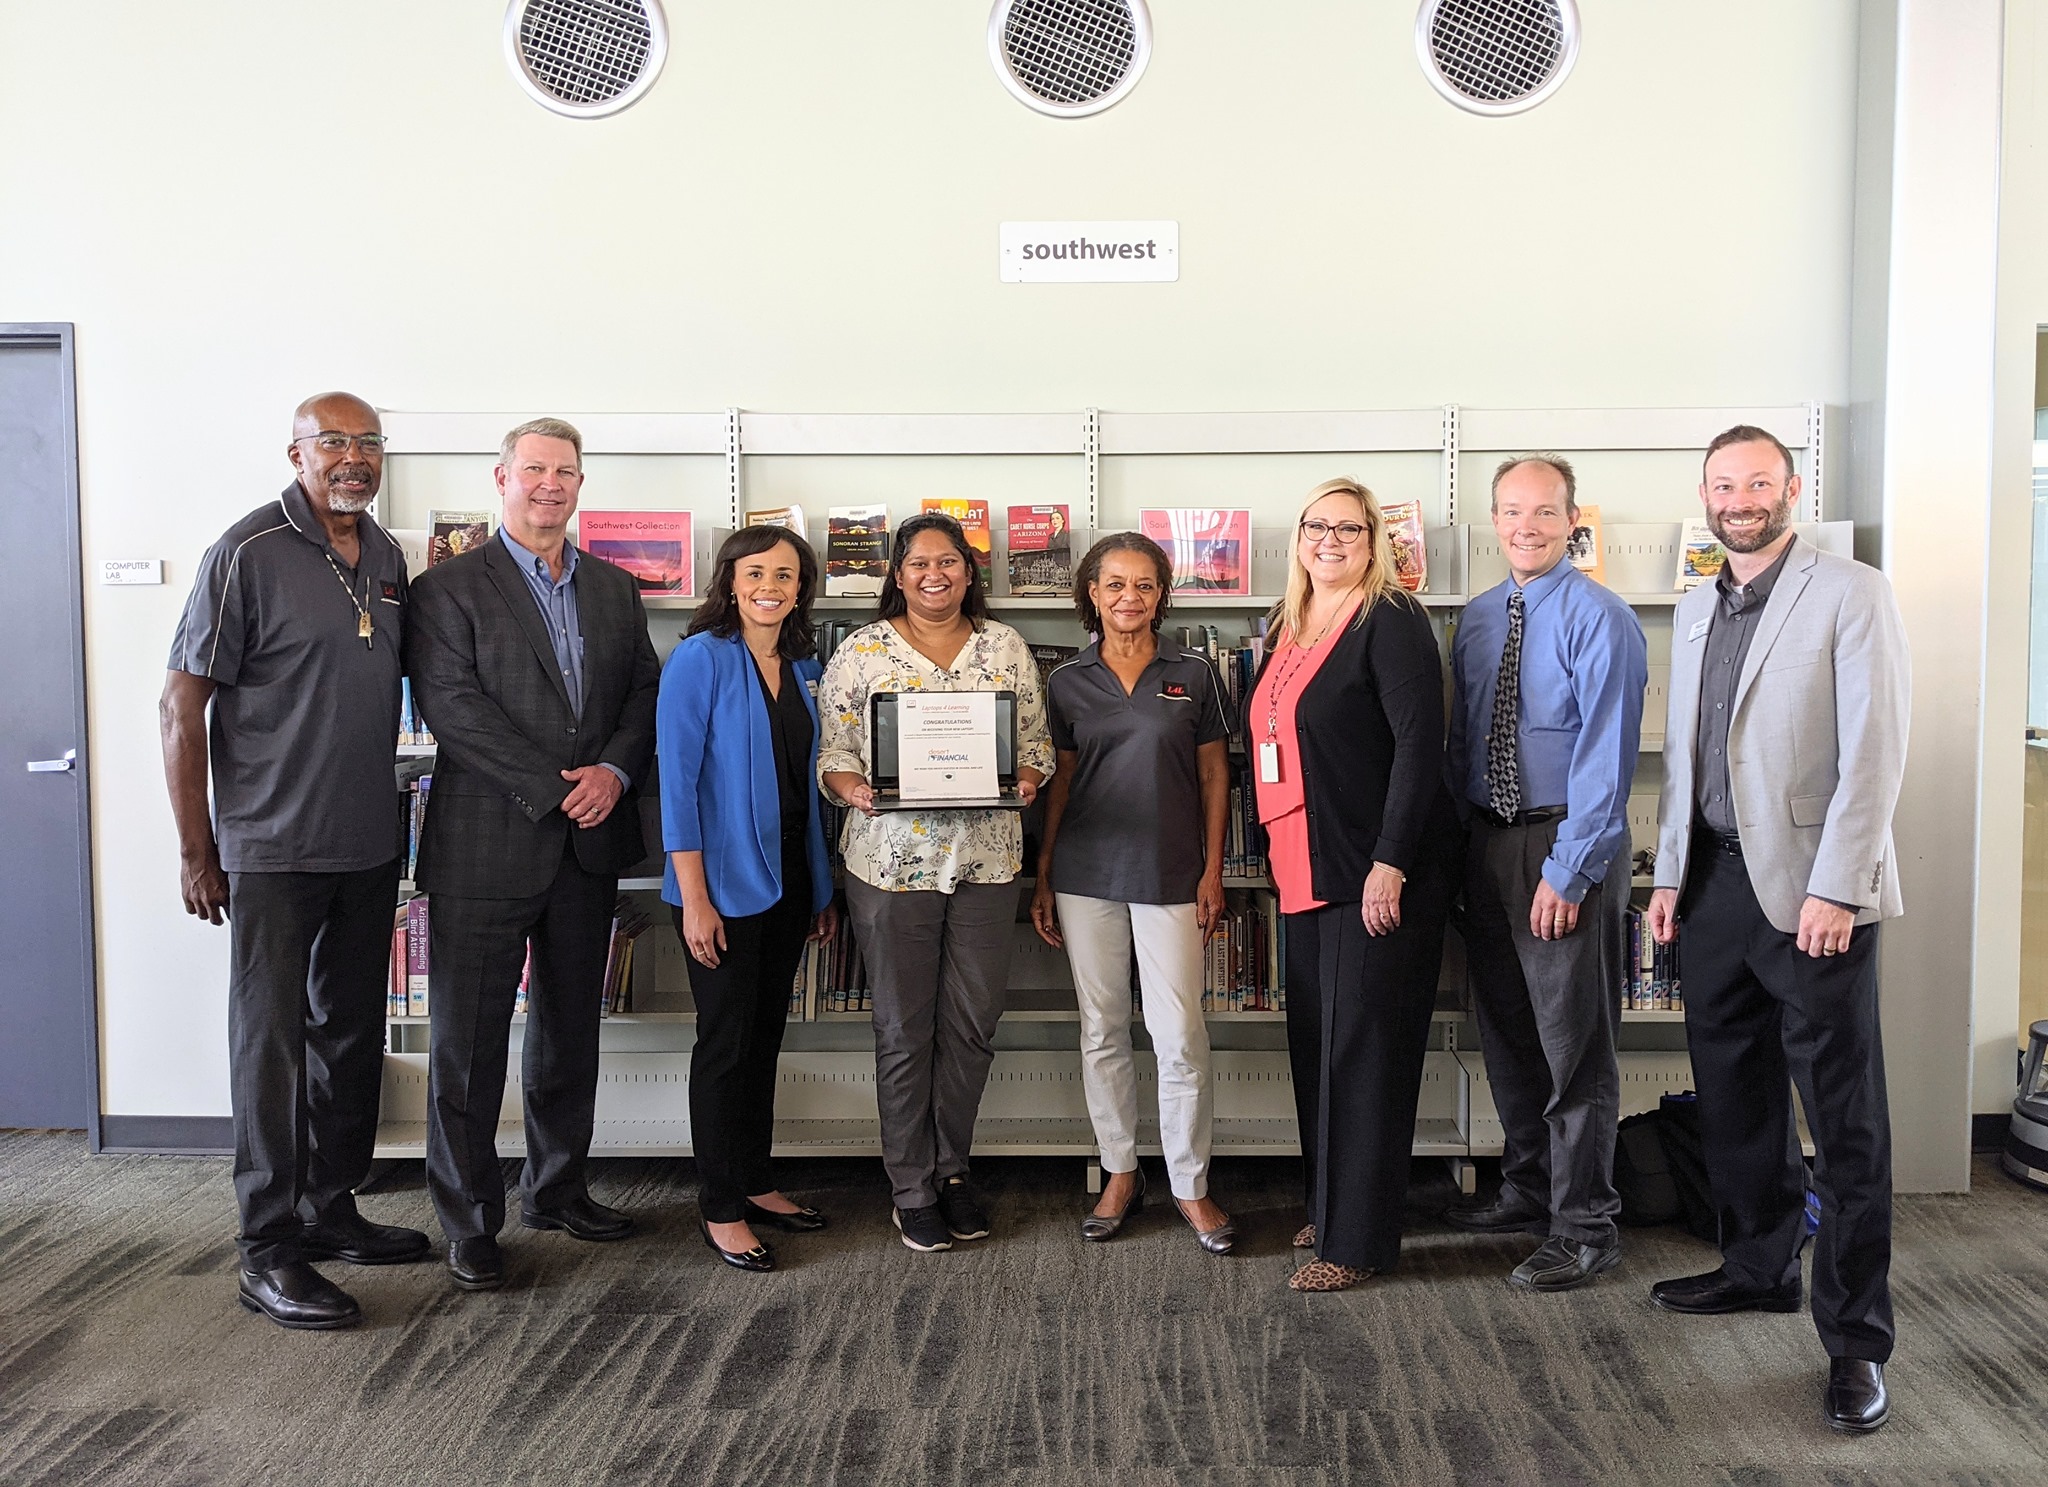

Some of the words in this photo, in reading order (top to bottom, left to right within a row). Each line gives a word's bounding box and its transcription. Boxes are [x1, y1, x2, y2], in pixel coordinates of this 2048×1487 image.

[1022, 237, 1156, 260] southwest
[953, 506, 984, 520] FLAT
[587, 521, 633, 530] Southwest
[635, 521, 680, 530] Collection
[105, 562, 150, 570] COMPUTER
[105, 571, 121, 579] LAB
[1167, 685, 1185, 694] L4L
[1246, 784, 1254, 823] ARIZONA
[410, 919, 418, 935] Bird
[418, 906, 427, 935] Arizona
[410, 937, 418, 957] Atlas
[417, 937, 427, 970] Breeding
[1217, 944, 1226, 958] LAST
[1217, 959, 1226, 987] GUNFIGHT
